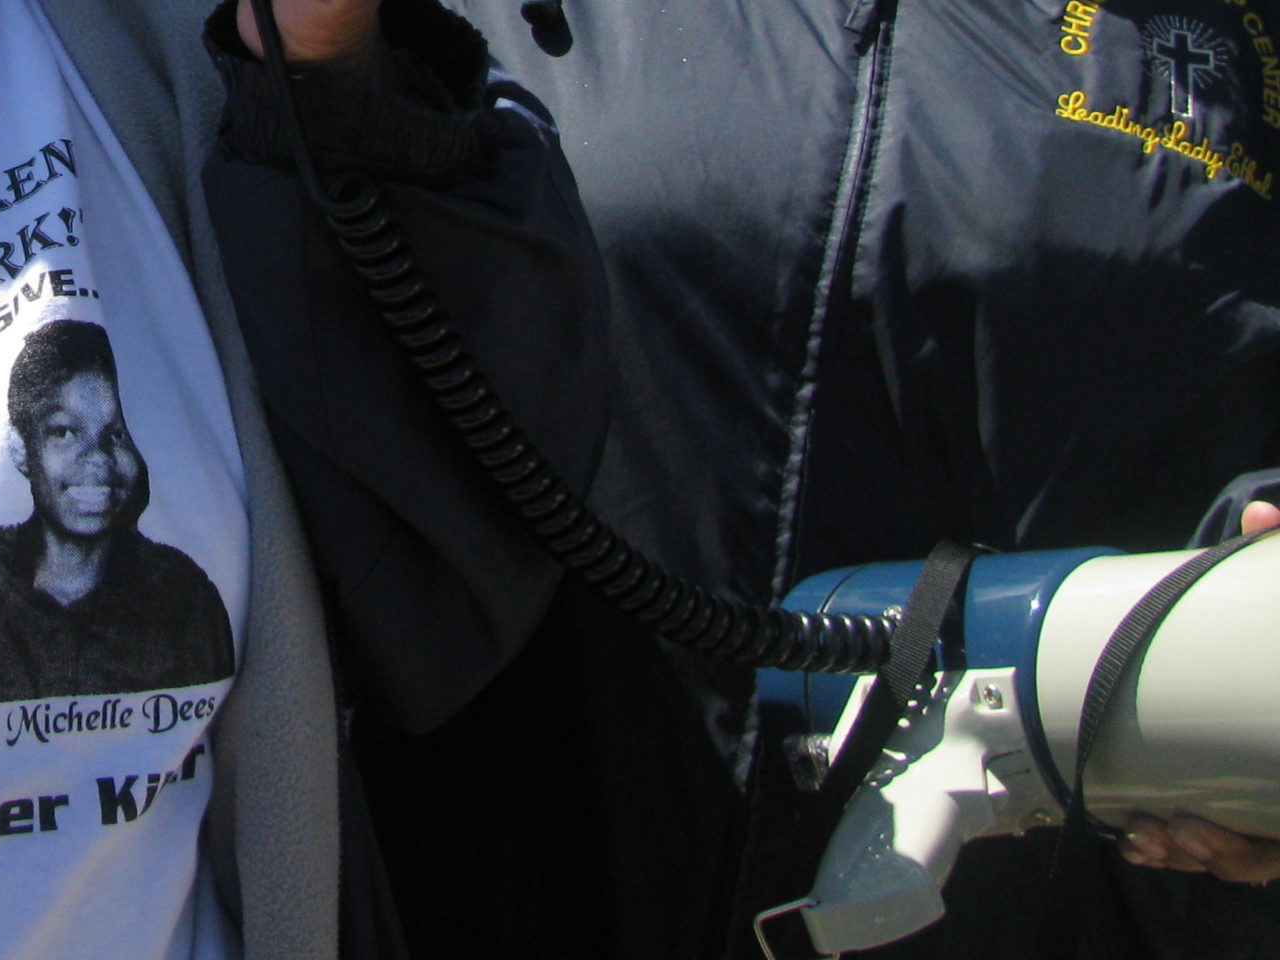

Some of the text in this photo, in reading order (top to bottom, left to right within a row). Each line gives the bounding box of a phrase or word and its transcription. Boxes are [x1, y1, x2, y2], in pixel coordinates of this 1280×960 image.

[1055, 91, 1160, 154] Leading
[1160, 121, 1223, 179] Lady
[6, 699, 134, 747] Michelle
[142, 693, 216, 733] Dees
